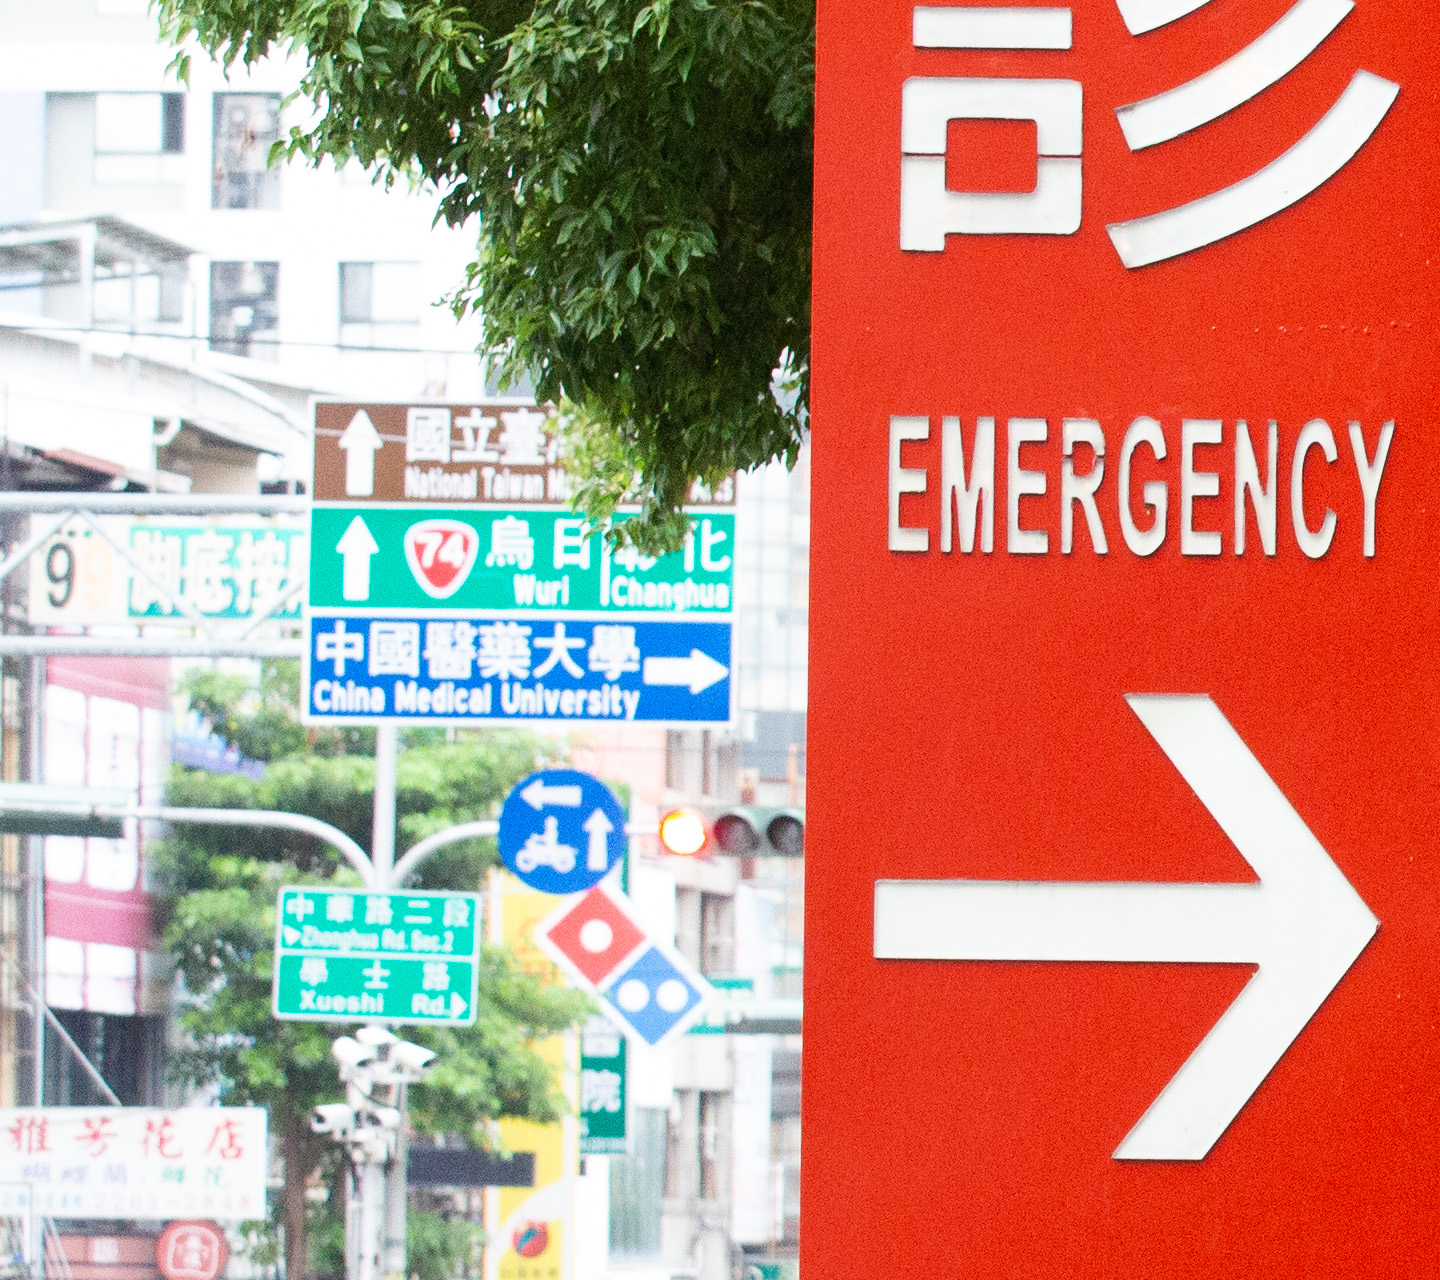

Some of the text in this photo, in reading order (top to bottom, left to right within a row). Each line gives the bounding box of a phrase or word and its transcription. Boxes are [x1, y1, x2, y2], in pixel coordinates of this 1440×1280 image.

[405, 466, 477, 500] National
[482, 468, 544, 501] Taiwan
[887, 414, 1397, 560] EMERGENCY
[416, 531, 469, 569] 74
[485, 516, 591, 570] 烏日
[513, 574, 569, 606] Wuri
[610, 577, 729, 611] Changhua
[316, 621, 640, 681] 中國醫藥大學
[313, 680, 640, 719] China Medical University
[285, 892, 470, 928] 中華路二段
[299, 958, 450, 991] 學士路
[299, 989, 451, 1016] Xueshi Rd.
